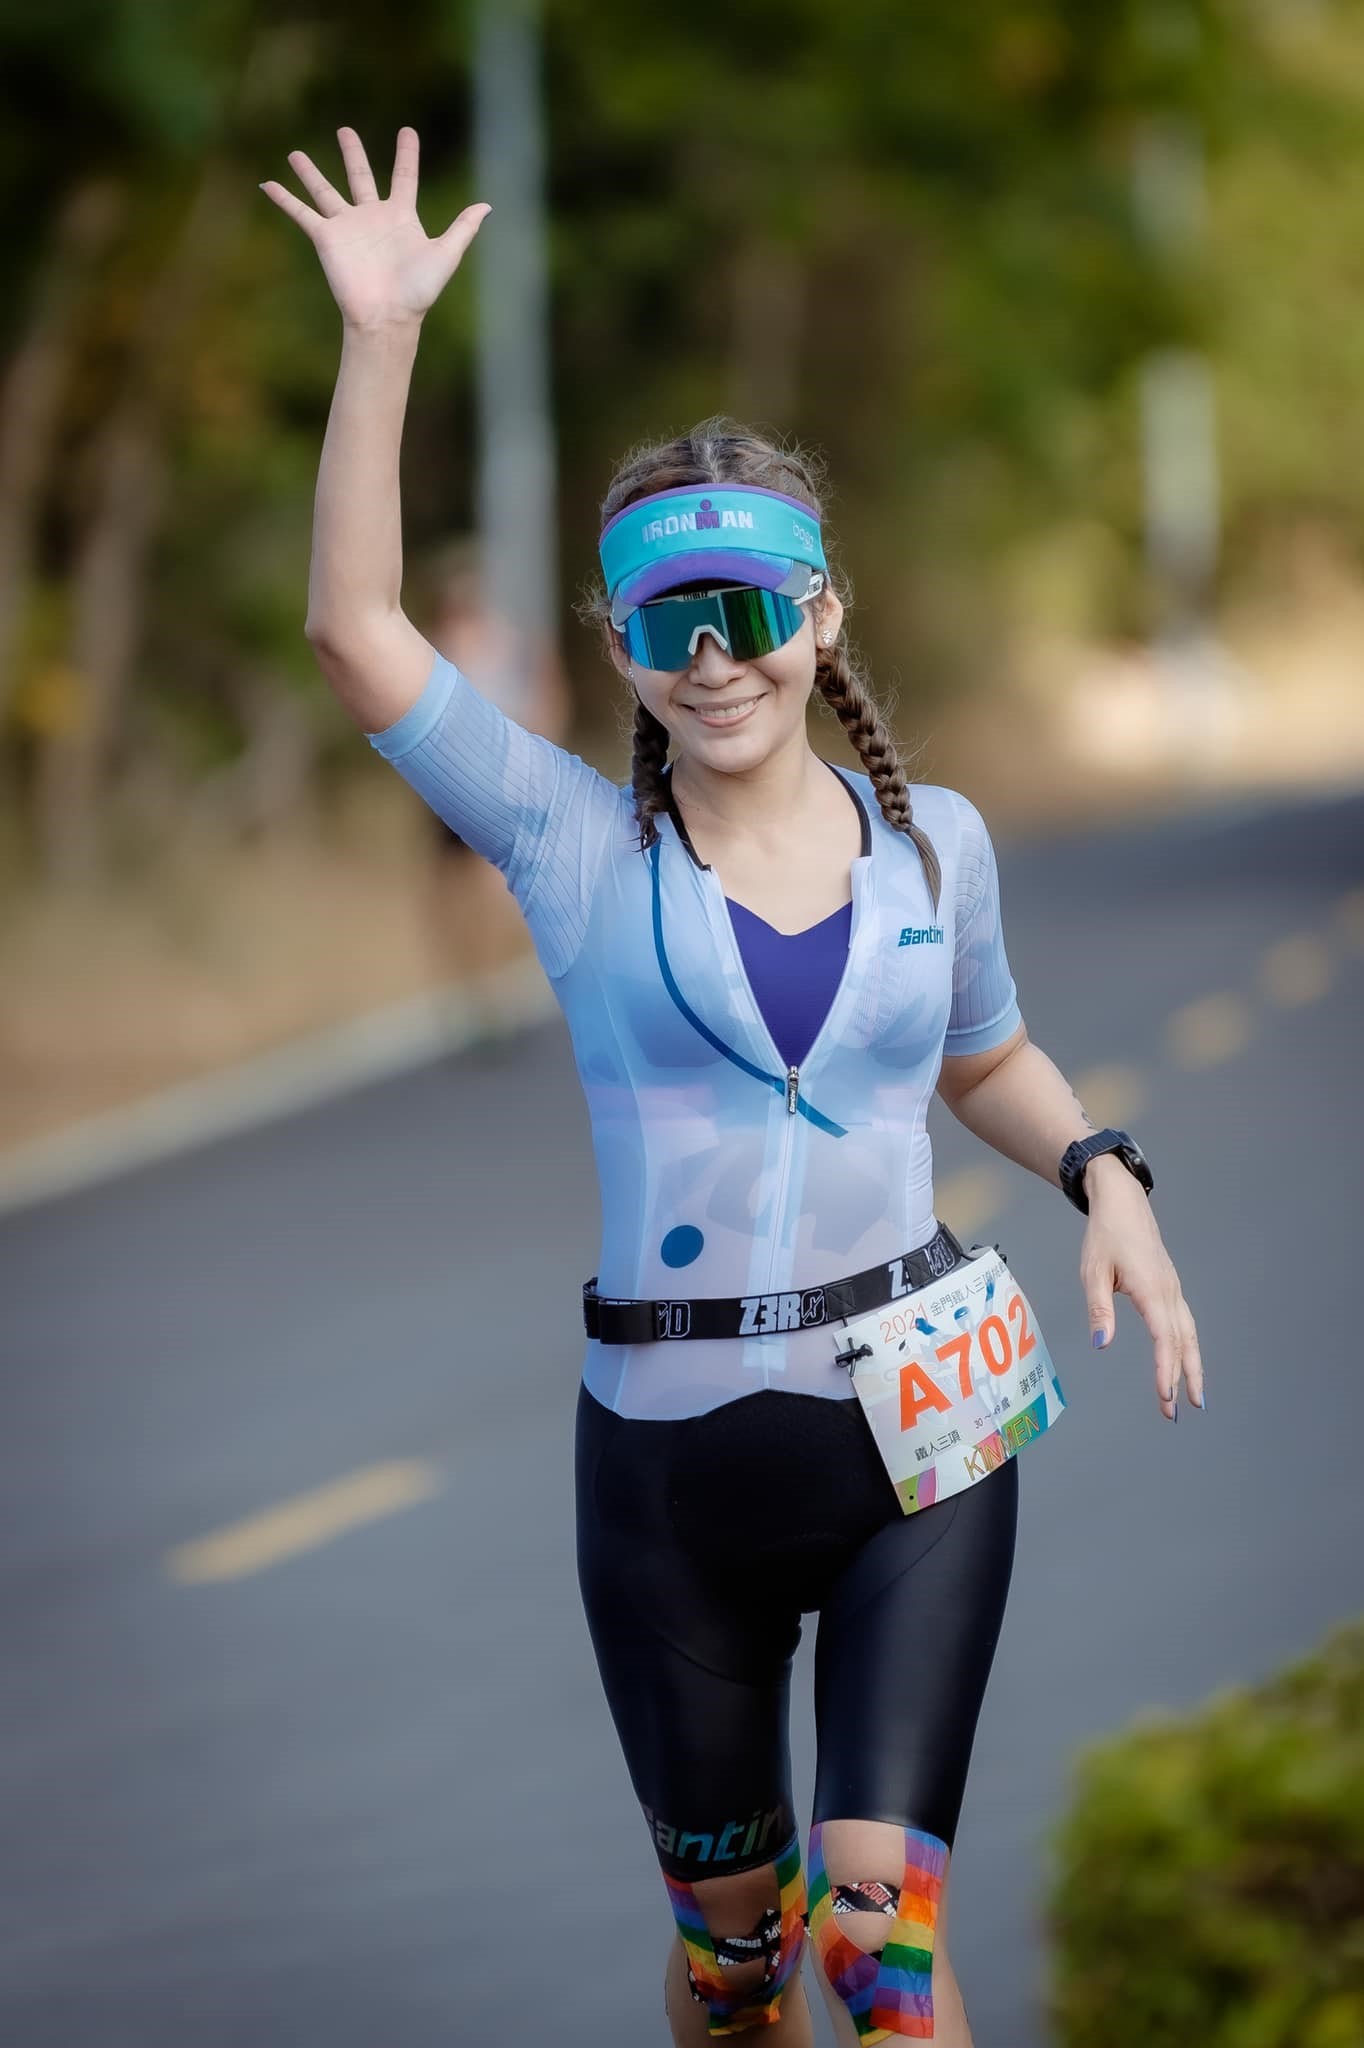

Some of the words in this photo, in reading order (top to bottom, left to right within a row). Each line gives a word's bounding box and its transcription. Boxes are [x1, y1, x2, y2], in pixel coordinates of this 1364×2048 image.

[641, 508, 754, 544] IRONMAN
[897, 925, 945, 947] Santini
[879, 1302, 930, 1343] 2021
[899, 1293, 1037, 1433] A702
[914, 1429, 962, 1462] 鐵人三項
[962, 1407, 1041, 1482] KINMEN
